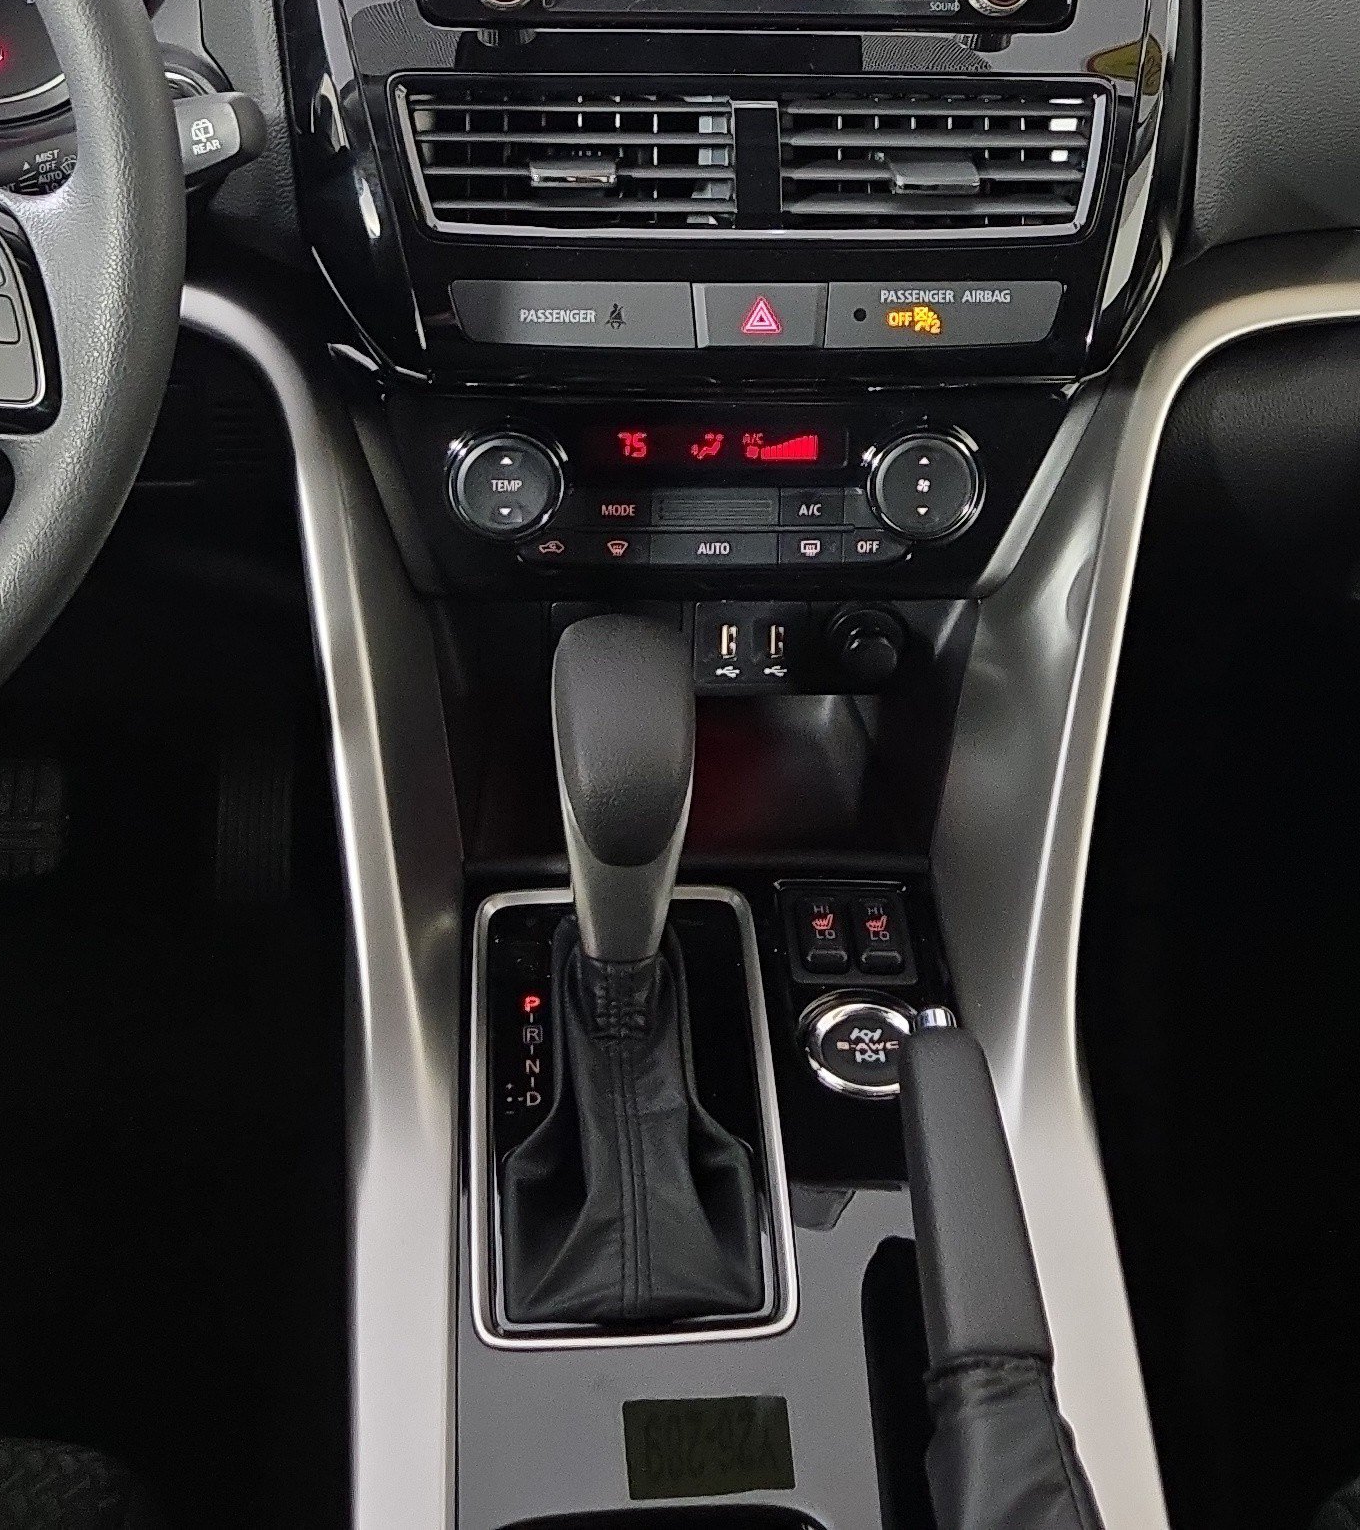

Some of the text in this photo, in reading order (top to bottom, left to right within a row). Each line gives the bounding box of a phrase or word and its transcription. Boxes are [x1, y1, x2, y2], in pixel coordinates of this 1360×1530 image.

[929, 2, 961, 12] SOUND
[192, 138, 221, 155] REAR
[35, 149, 60, 163] MIST
[38, 161, 57, 173] OFF
[38, 170, 63, 184] AUTO
[880, 290, 1011, 303] PASSENGER AIRBAG
[519, 307, 596, 324] PASSENGER
[888, 311, 913, 327] OFF
[617, 431, 647, 458] 75
[491, 478, 523, 494] TEMP
[601, 502, 636, 518] MODE
[799, 502, 822, 519] A/C
[697, 541, 730, 557] AUTO
[857, 540, 879, 555] OFF
[813, 905, 830, 915] HI
[867, 907, 884, 916] HI
[816, 930, 836, 940] LO
[870, 931, 890, 941] LO
[524, 995, 541, 1012] P
[526, 1028, 540, 1042] R
[525, 1059, 540, 1074] N
[526, 1091, 542, 1107] D
